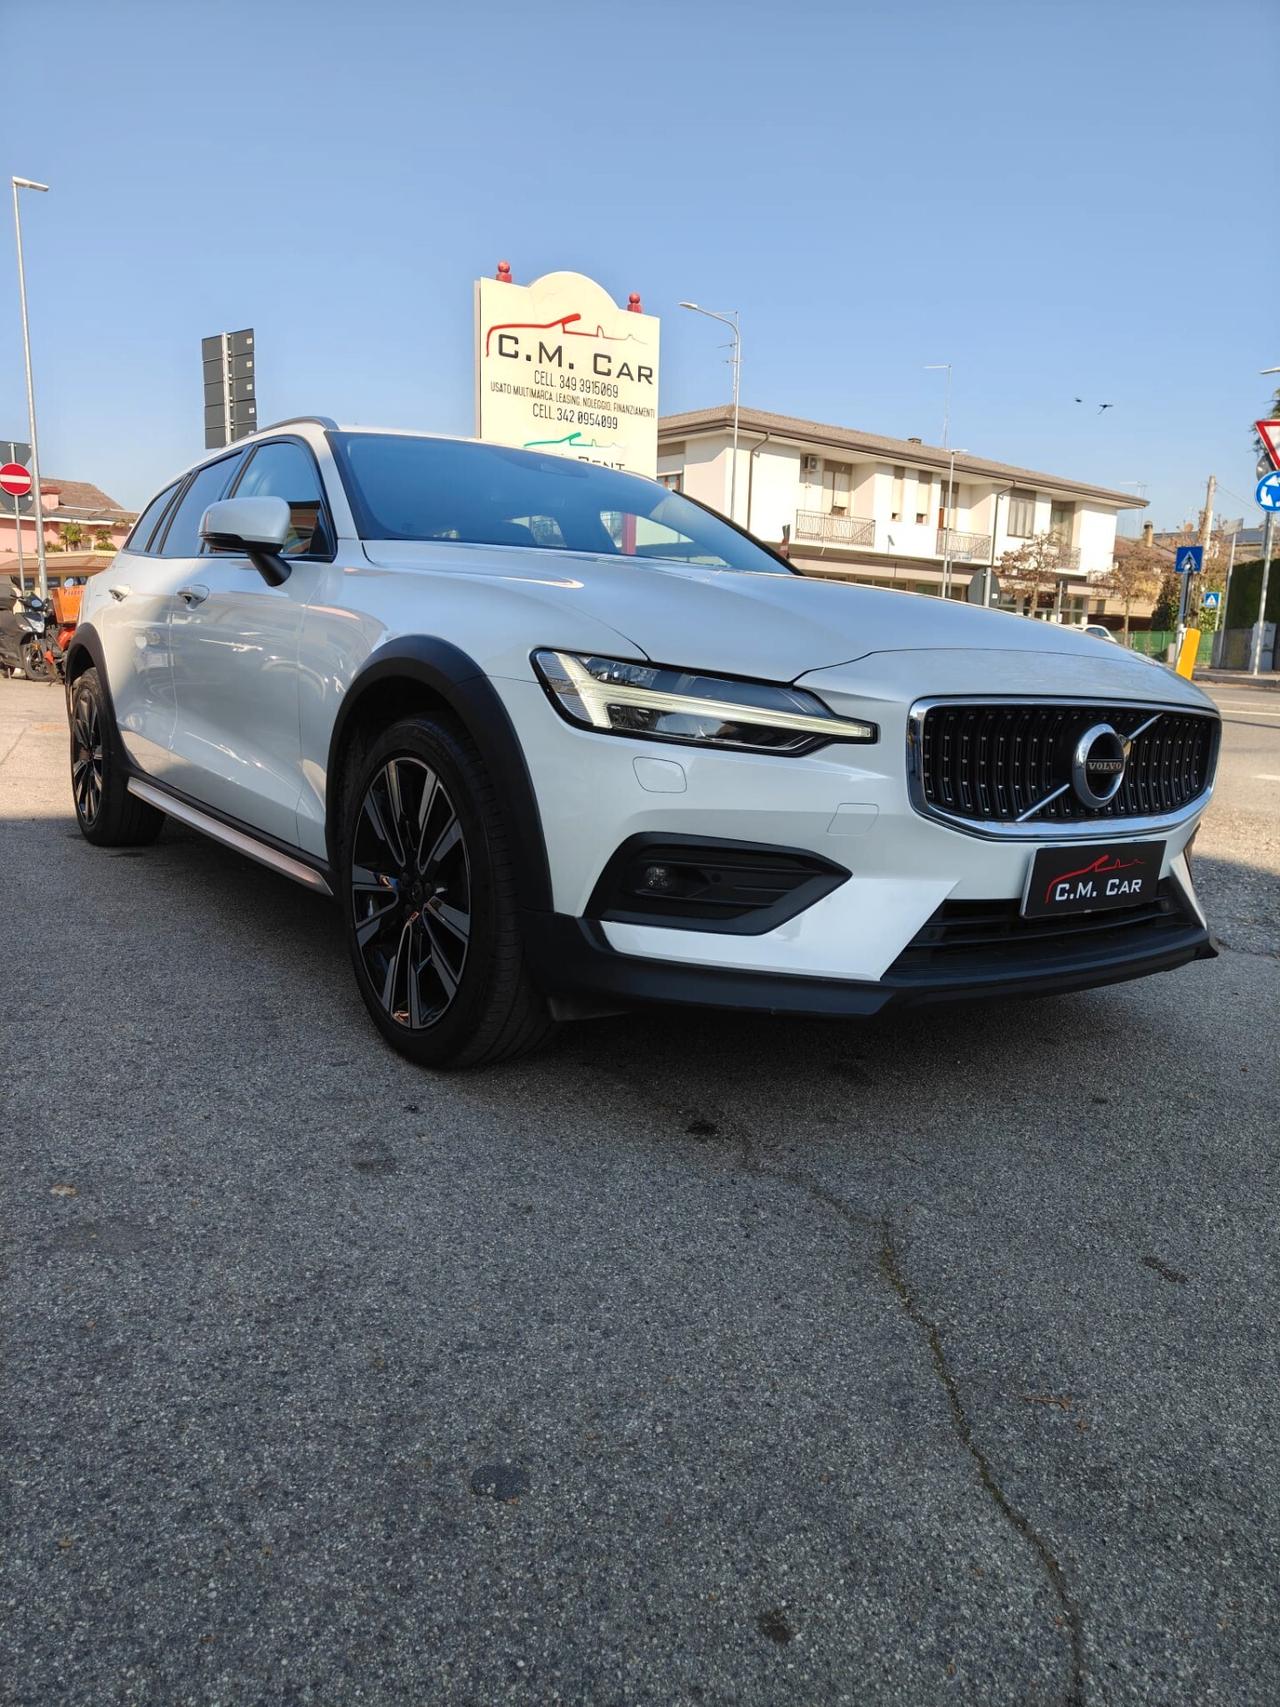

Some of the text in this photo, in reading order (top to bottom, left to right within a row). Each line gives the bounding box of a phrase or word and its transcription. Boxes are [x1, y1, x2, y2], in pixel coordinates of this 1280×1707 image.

[498, 333, 574, 370] C.M.
[534, 369, 619, 399] CELL. 349 3915069
[490, 381, 512, 395] USATO
[613, 402, 656, 419] FINANZIAMENTI
[532, 403, 618, 430] CELL. 342 0954099
[1087, 761, 1122, 771] VOLVO
[1055, 880, 1097, 901] C.M.
